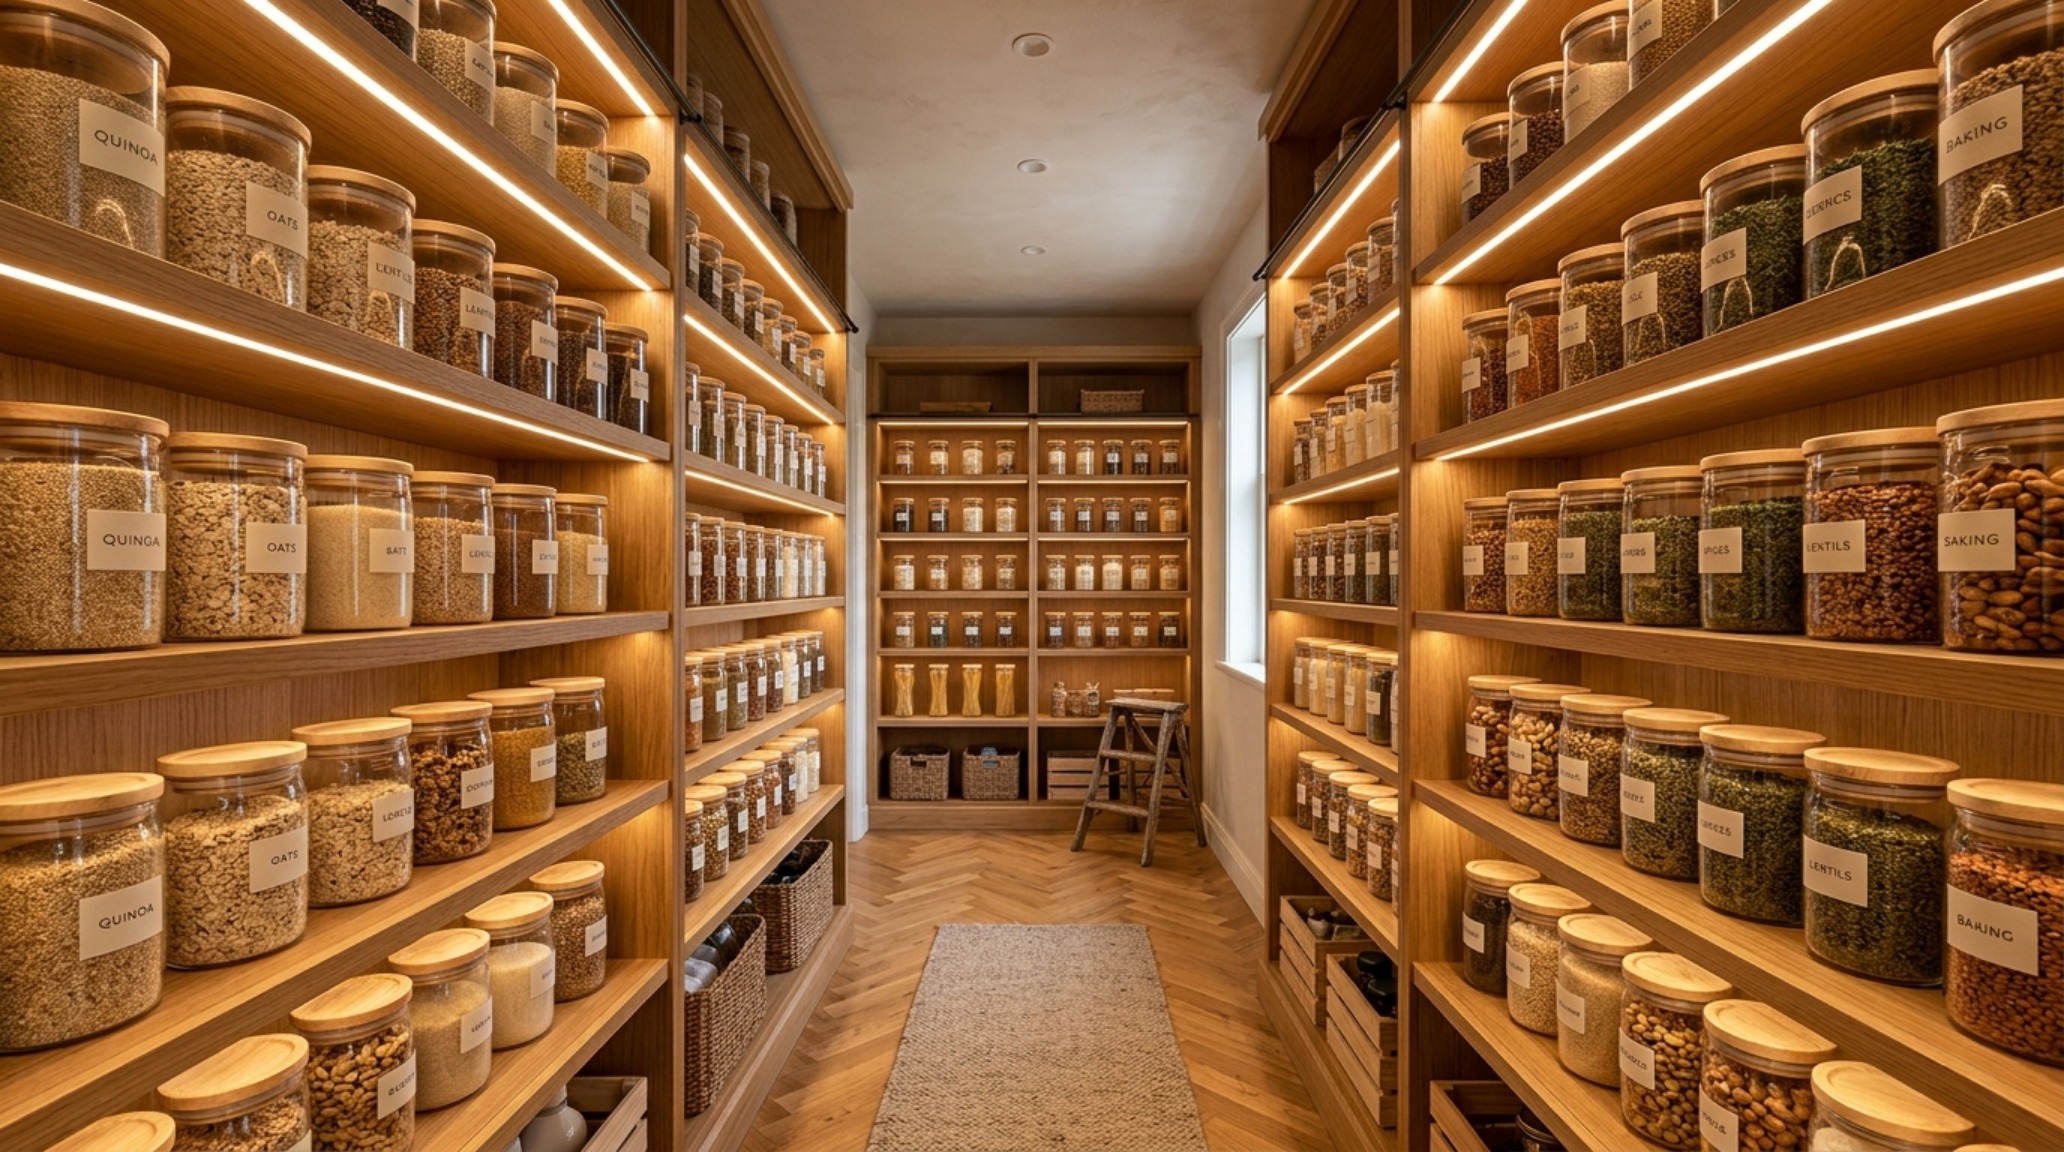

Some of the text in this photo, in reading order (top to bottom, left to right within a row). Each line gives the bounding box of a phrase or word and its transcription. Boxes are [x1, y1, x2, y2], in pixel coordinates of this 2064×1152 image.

[1946, 116, 2008, 154] BAKING
[94, 129, 158, 166] QUINOA
[267, 210, 298, 231] OATS
[267, 543, 297, 553] OATS
[1944, 533, 1999, 547] SAKING
[271, 850, 298, 865] OATS
[98, 903, 154, 929] QUINOA
